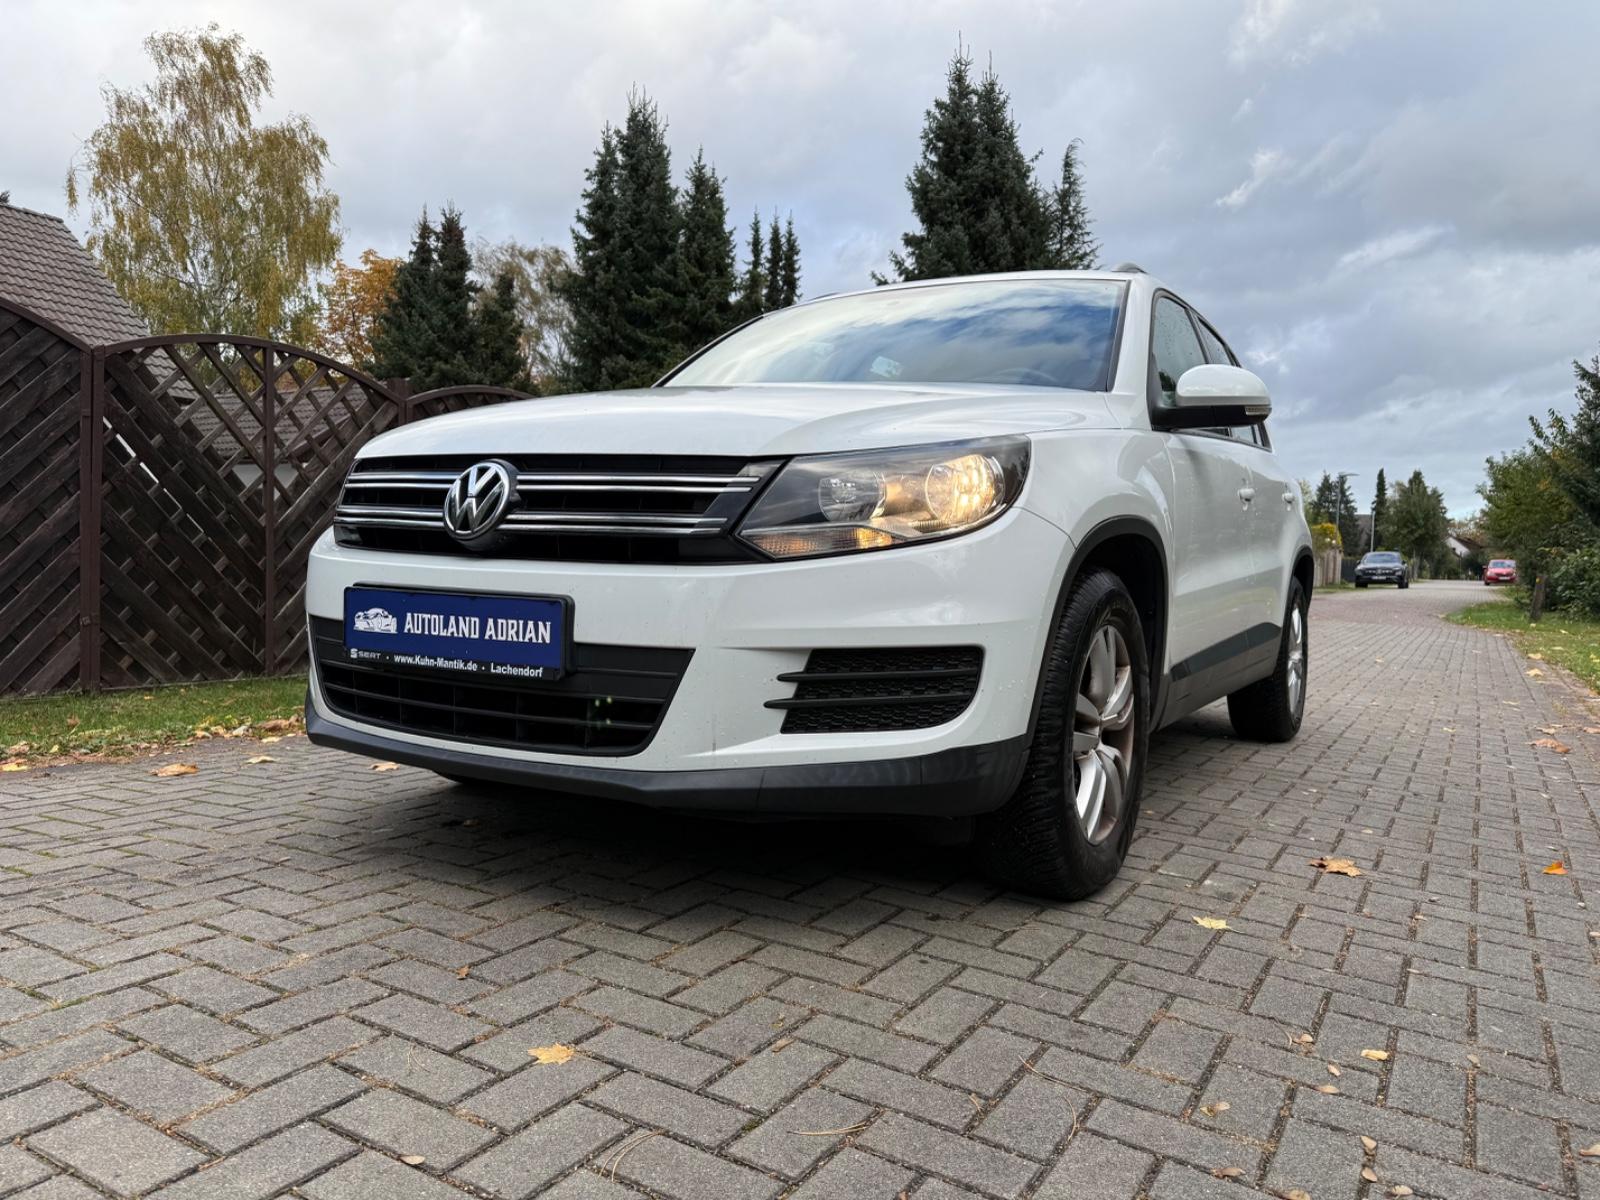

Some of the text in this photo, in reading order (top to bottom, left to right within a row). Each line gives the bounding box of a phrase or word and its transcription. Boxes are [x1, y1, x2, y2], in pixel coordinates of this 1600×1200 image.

[404, 612, 551, 644] AUTOLAND ADRIAN
[394, 654, 478, 672] www.Kuhn-Mantik.de
[490, 662, 543, 677] Lachendorf
